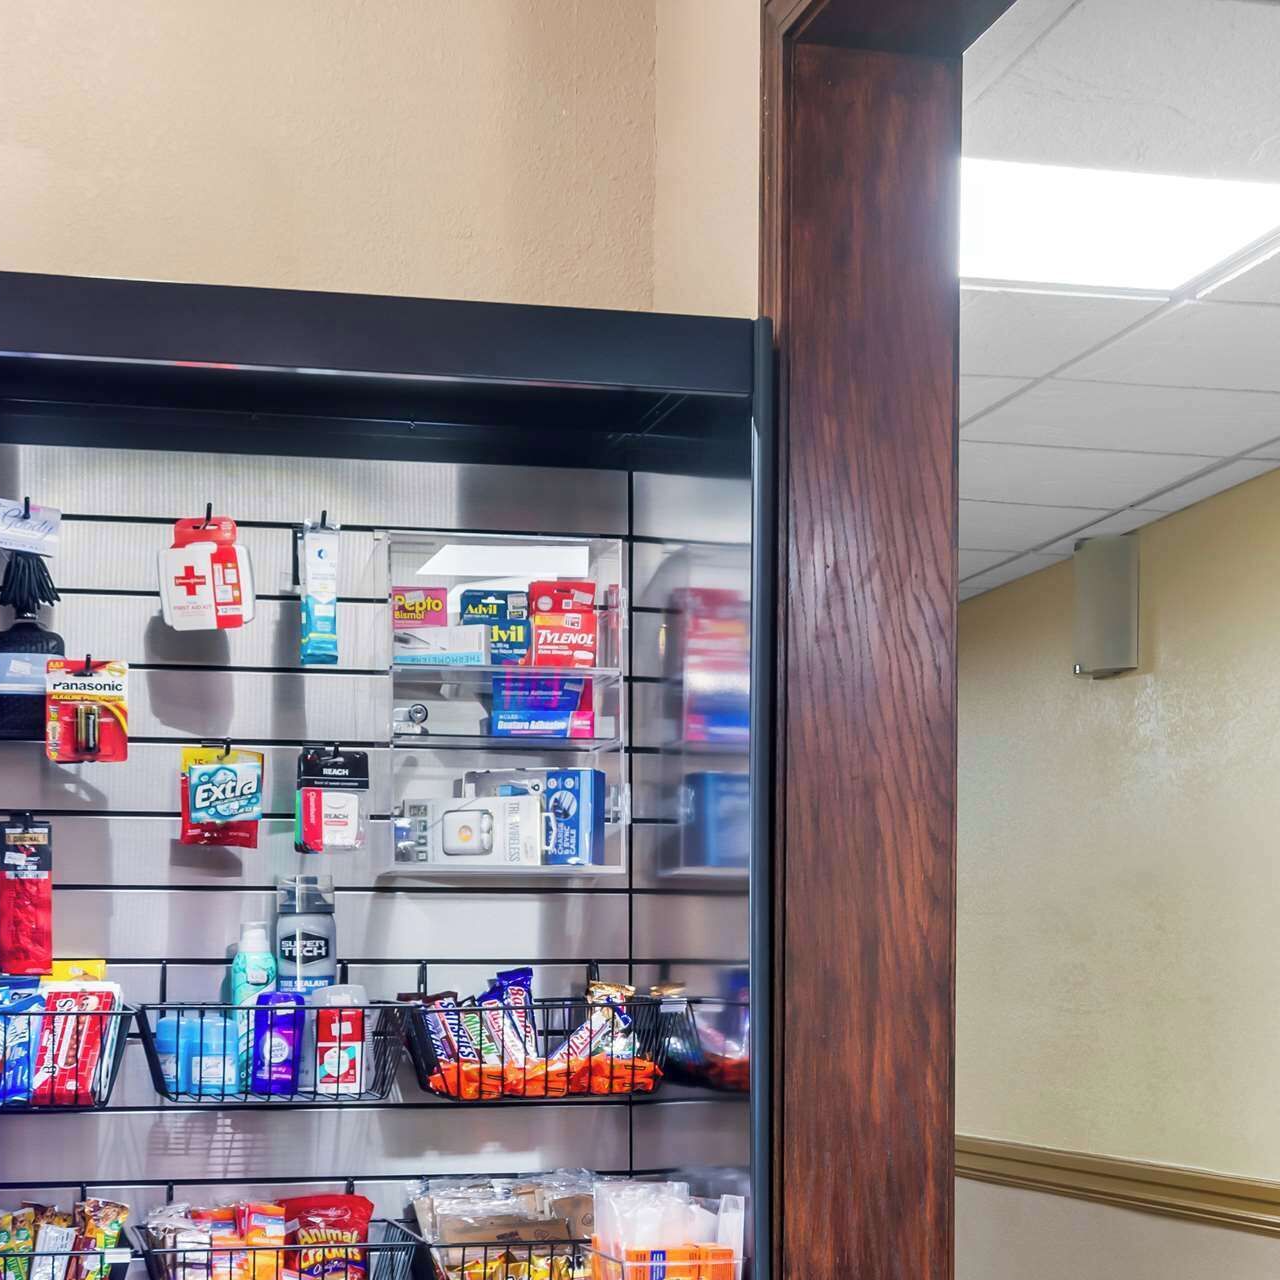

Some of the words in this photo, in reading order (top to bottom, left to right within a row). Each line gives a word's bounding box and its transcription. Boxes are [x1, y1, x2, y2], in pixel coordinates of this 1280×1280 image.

[394, 594, 444, 613] Pepto
[464, 604, 497, 615] Advil
[490, 625, 524, 642] vil
[537, 629, 594, 645] TYLENOL
[52, 680, 124, 692] Panasonic
[322, 767, 349, 777] REACH
[194, 767, 258, 810] Extra
[281, 947, 327, 957] TECH
[298, 1228, 358, 1244] Animal
[299, 1247, 361, 1267] Crackers
